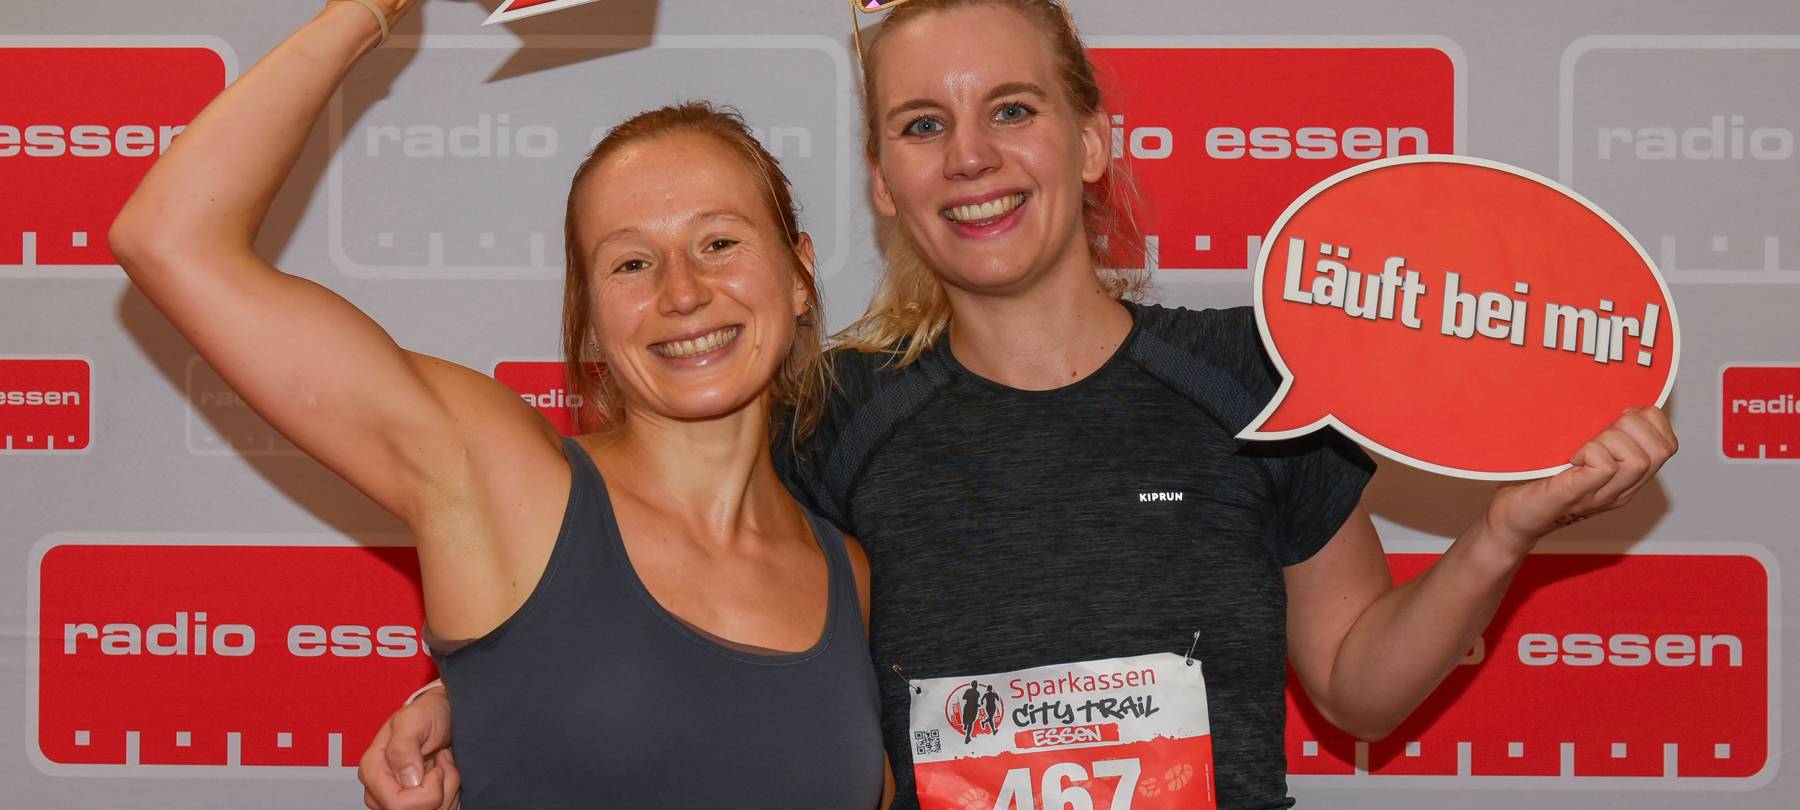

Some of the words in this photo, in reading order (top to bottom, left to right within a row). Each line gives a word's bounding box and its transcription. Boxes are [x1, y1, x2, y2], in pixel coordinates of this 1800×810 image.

[366, 113, 559, 158] radio
[1205, 126, 1430, 159] essen
[1598, 114, 1794, 160] radio
[1283, 237, 1426, 329] Läuft
[1441, 271, 1529, 347] bei
[1543, 299, 1660, 367] mir!
[520, 388, 584, 408] adio
[1732, 394, 1800, 414] radi
[1139, 491, 1184, 502] KIPRUN
[63, 611, 256, 656] radio
[287, 624, 432, 658] ess
[1517, 633, 1743, 667] essen
[1009, 667, 1156, 702] Sparkassen
[993, 757, 1142, 810] 467
